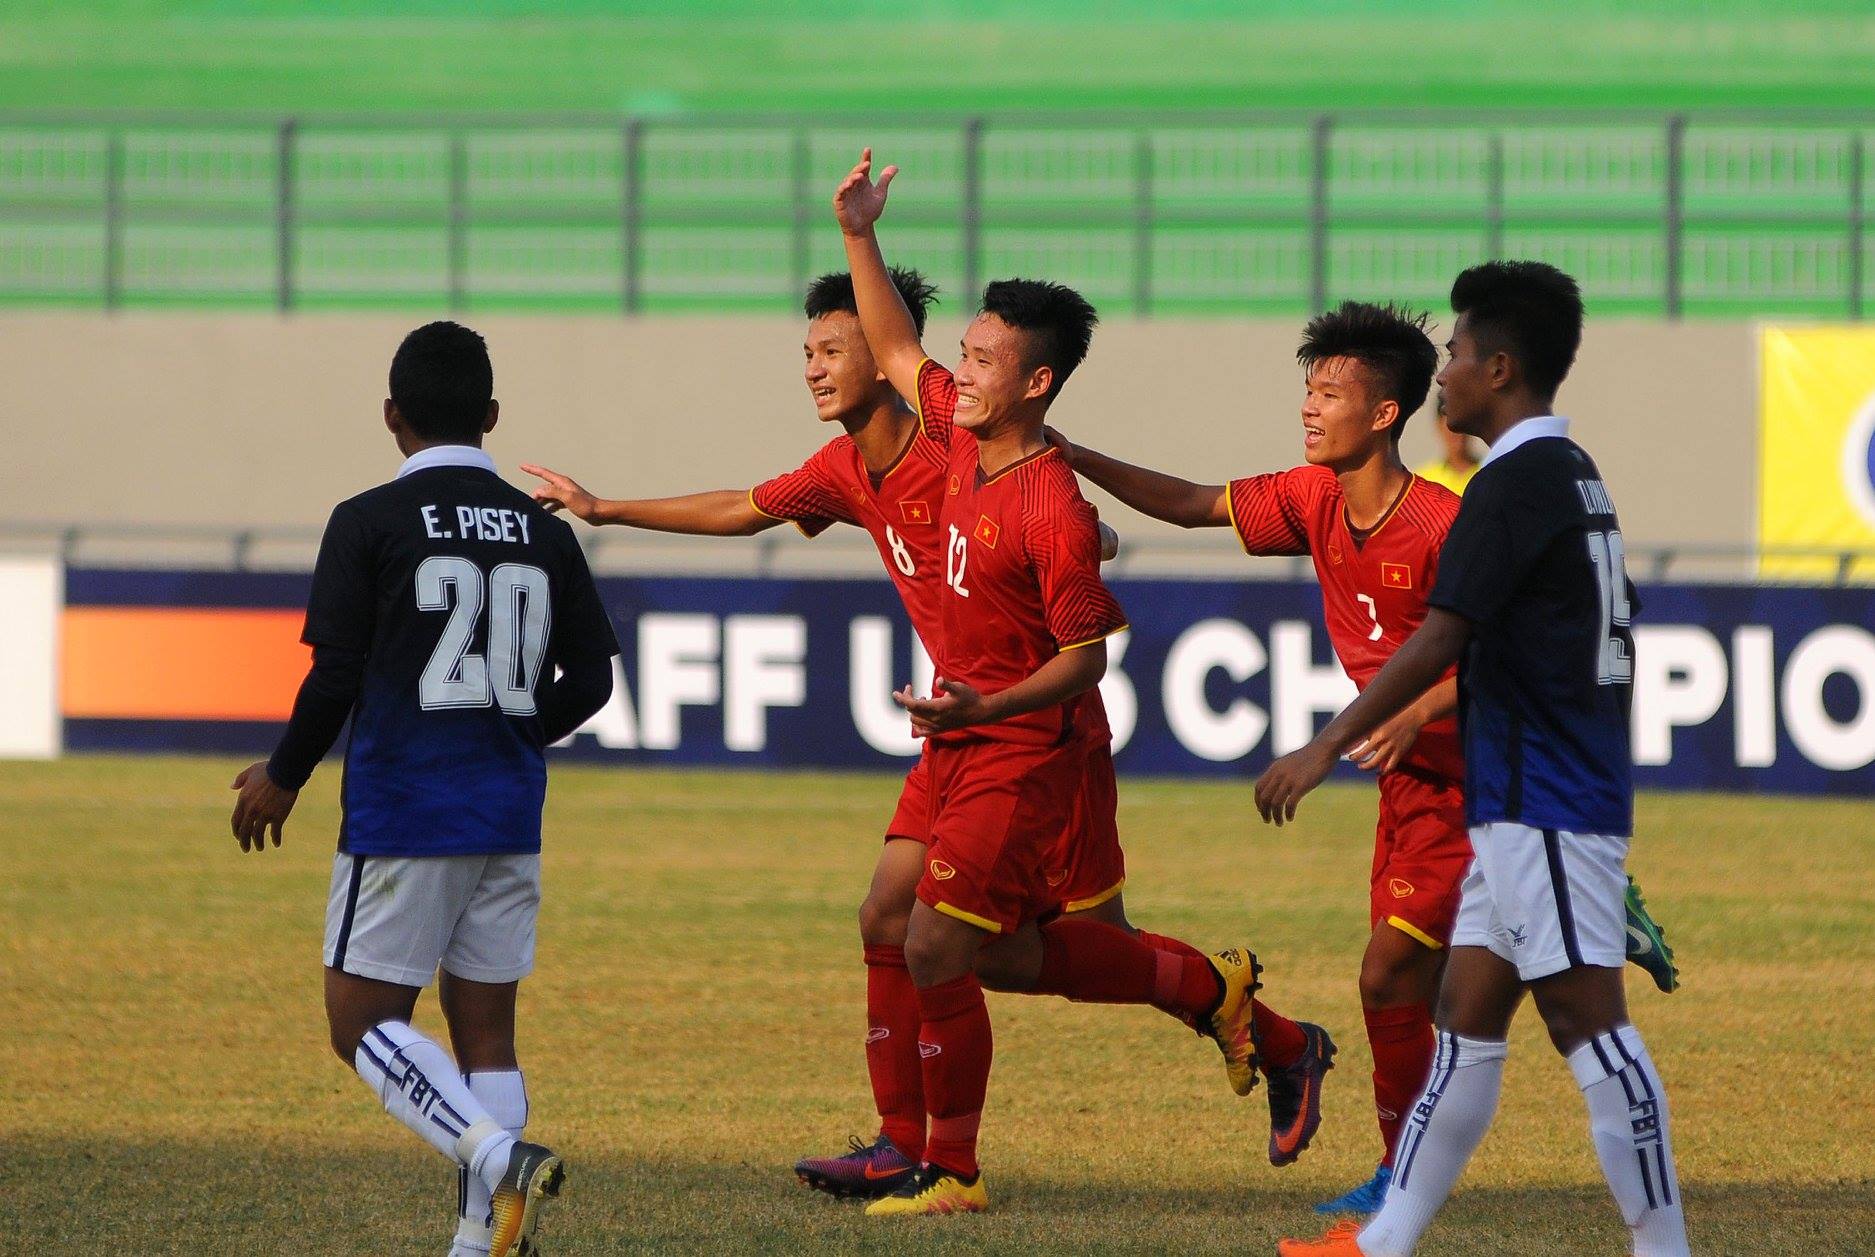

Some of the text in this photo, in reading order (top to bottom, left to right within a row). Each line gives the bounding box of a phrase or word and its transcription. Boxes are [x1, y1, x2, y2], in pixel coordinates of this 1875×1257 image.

[420, 504, 530, 545] E. PISEY
[885, 524, 916, 577] 8
[946, 522, 970, 598] 12
[415, 556, 551, 717] 20
[1356, 593, 1384, 642] 7
[399, 1062, 443, 1117] FBT
[1412, 1091, 1441, 1131] FBT
[1628, 1098, 1663, 1145] FBT
